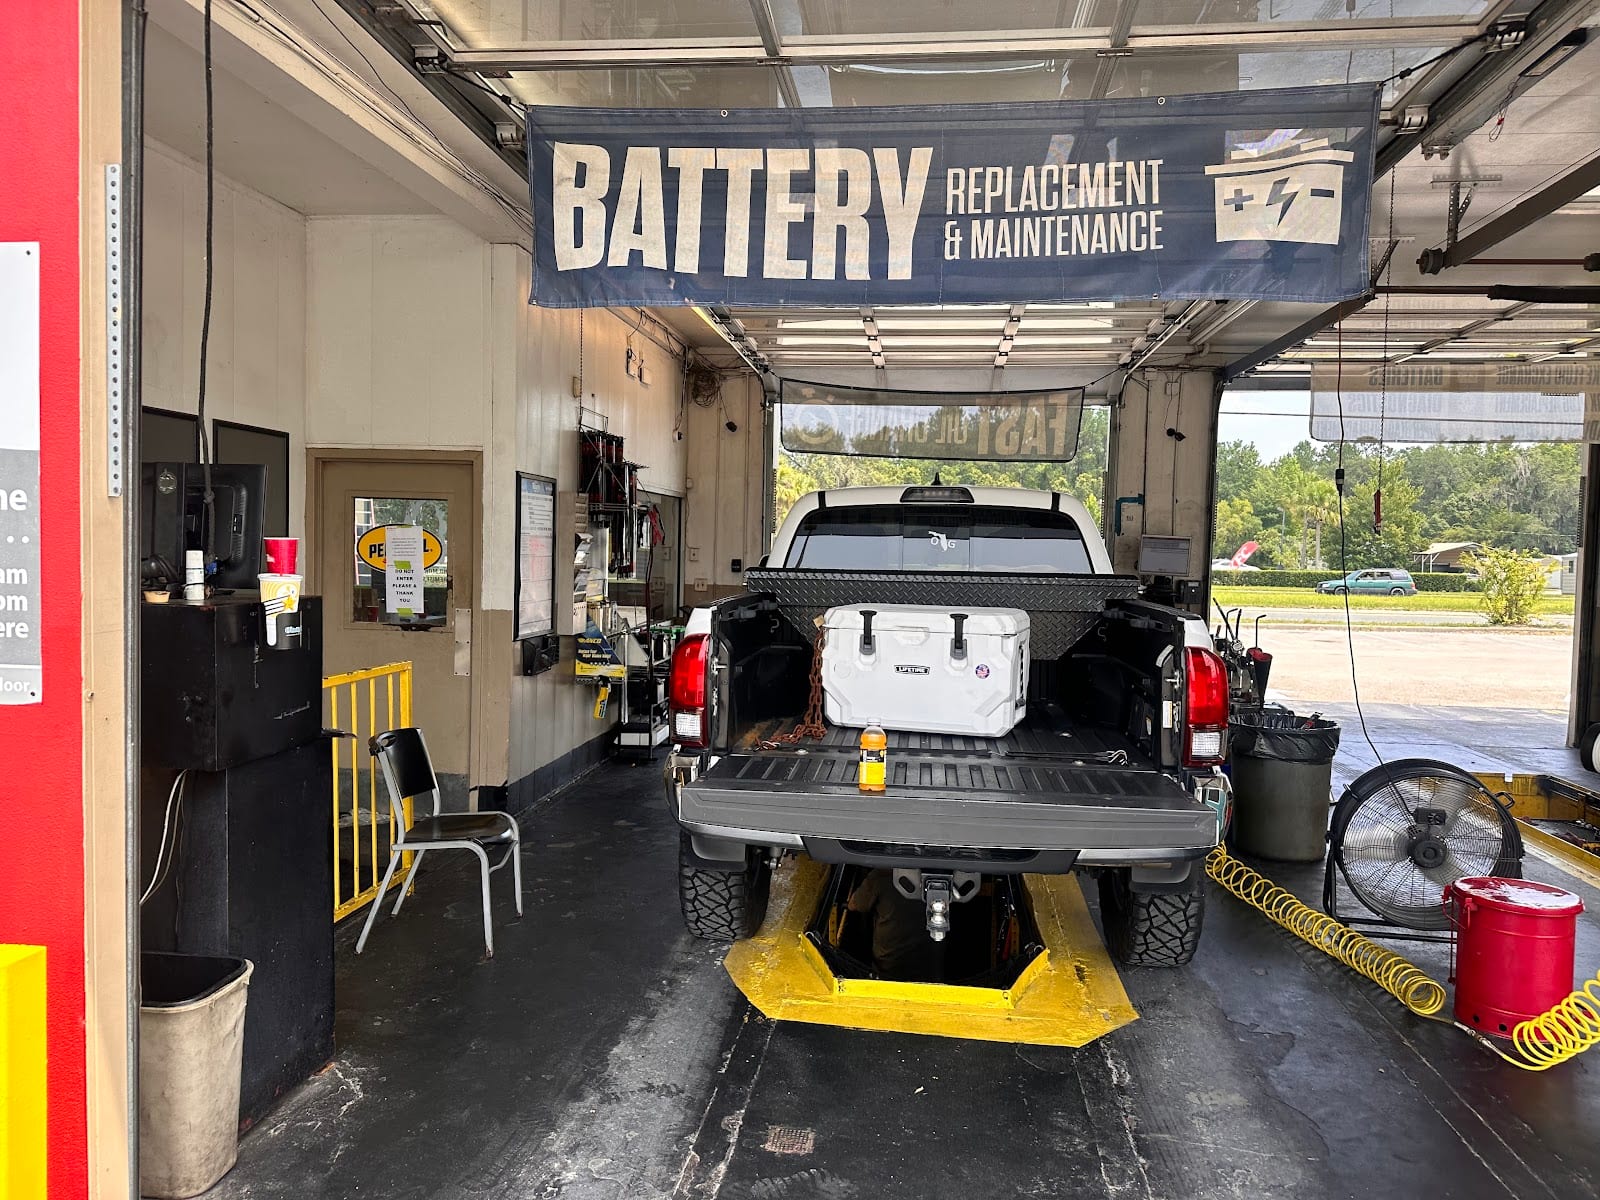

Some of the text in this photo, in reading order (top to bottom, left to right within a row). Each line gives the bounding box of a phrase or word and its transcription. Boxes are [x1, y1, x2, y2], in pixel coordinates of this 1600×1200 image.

[552, 140, 934, 282] BATTERY
[944, 158, 1164, 216] REPLACEMENT
[943, 209, 1165, 262] & MAINTENANCE
